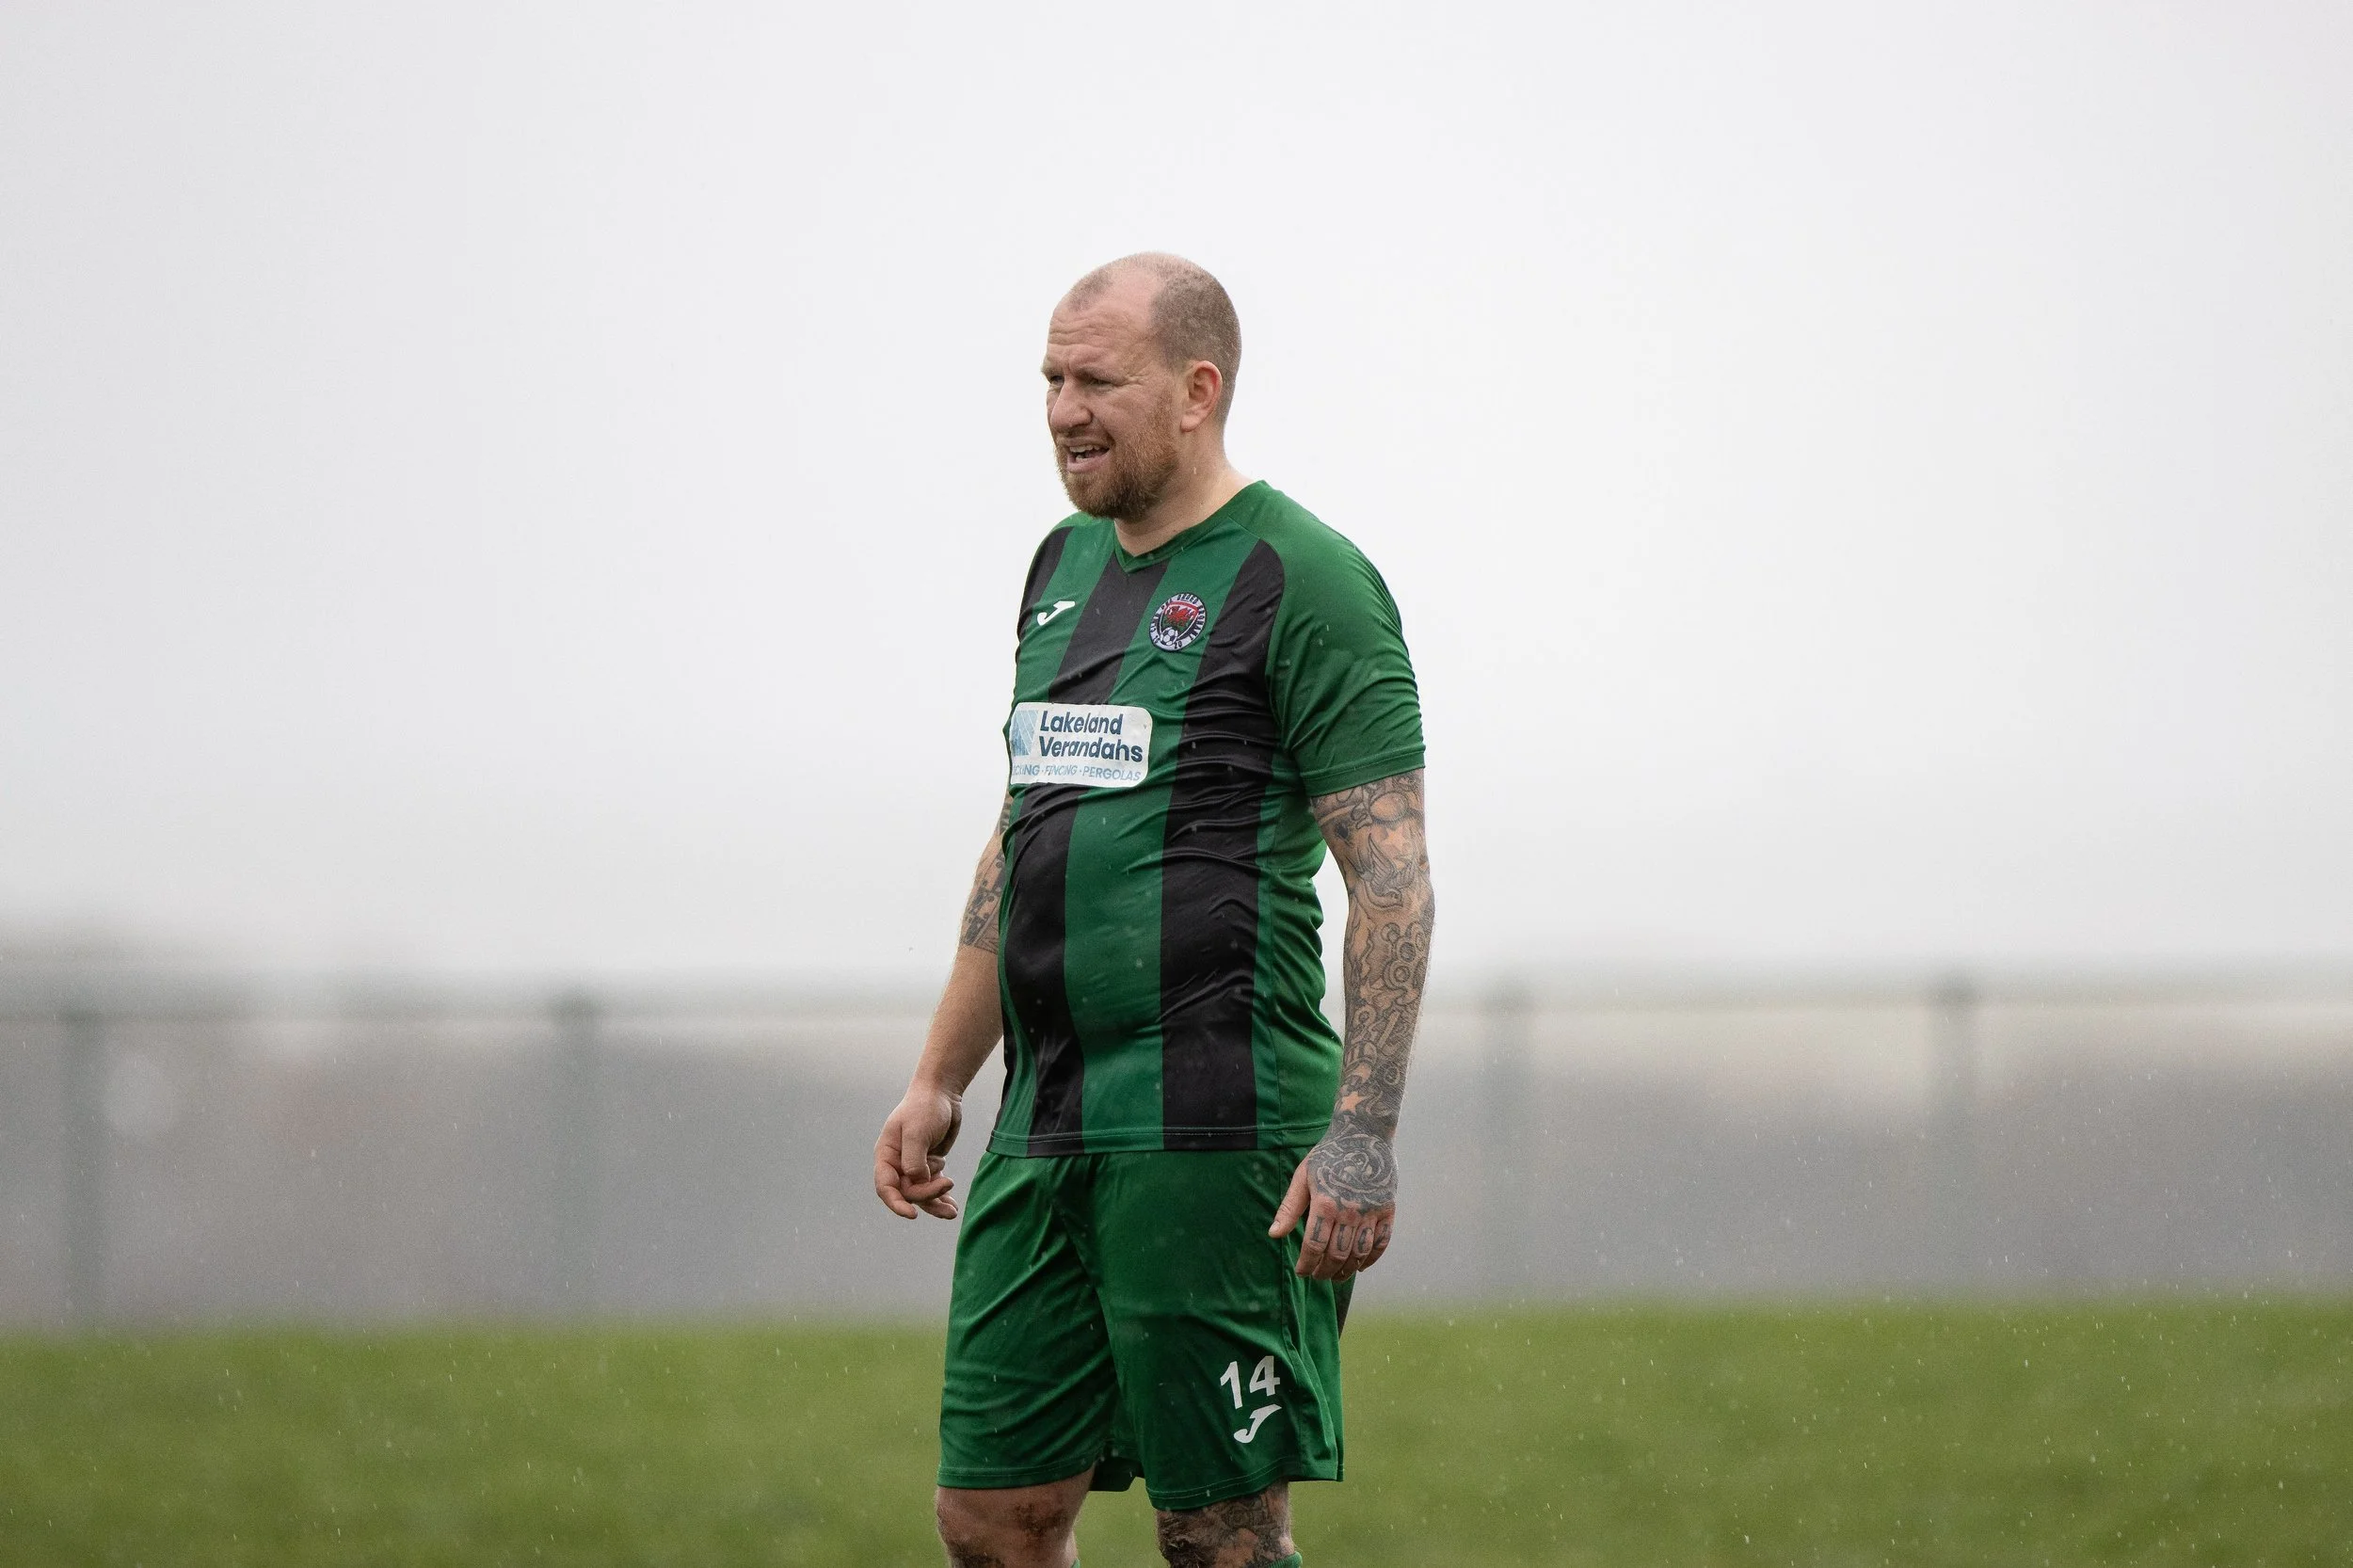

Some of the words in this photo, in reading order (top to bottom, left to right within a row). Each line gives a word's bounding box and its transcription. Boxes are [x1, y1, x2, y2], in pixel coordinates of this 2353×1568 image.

[1040, 711, 1124, 735] Lakeland
[1039, 736, 1144, 762] Verandahs
[1083, 766, 1142, 781] PERGOLAS
[1219, 1355, 1281, 1410] 14
